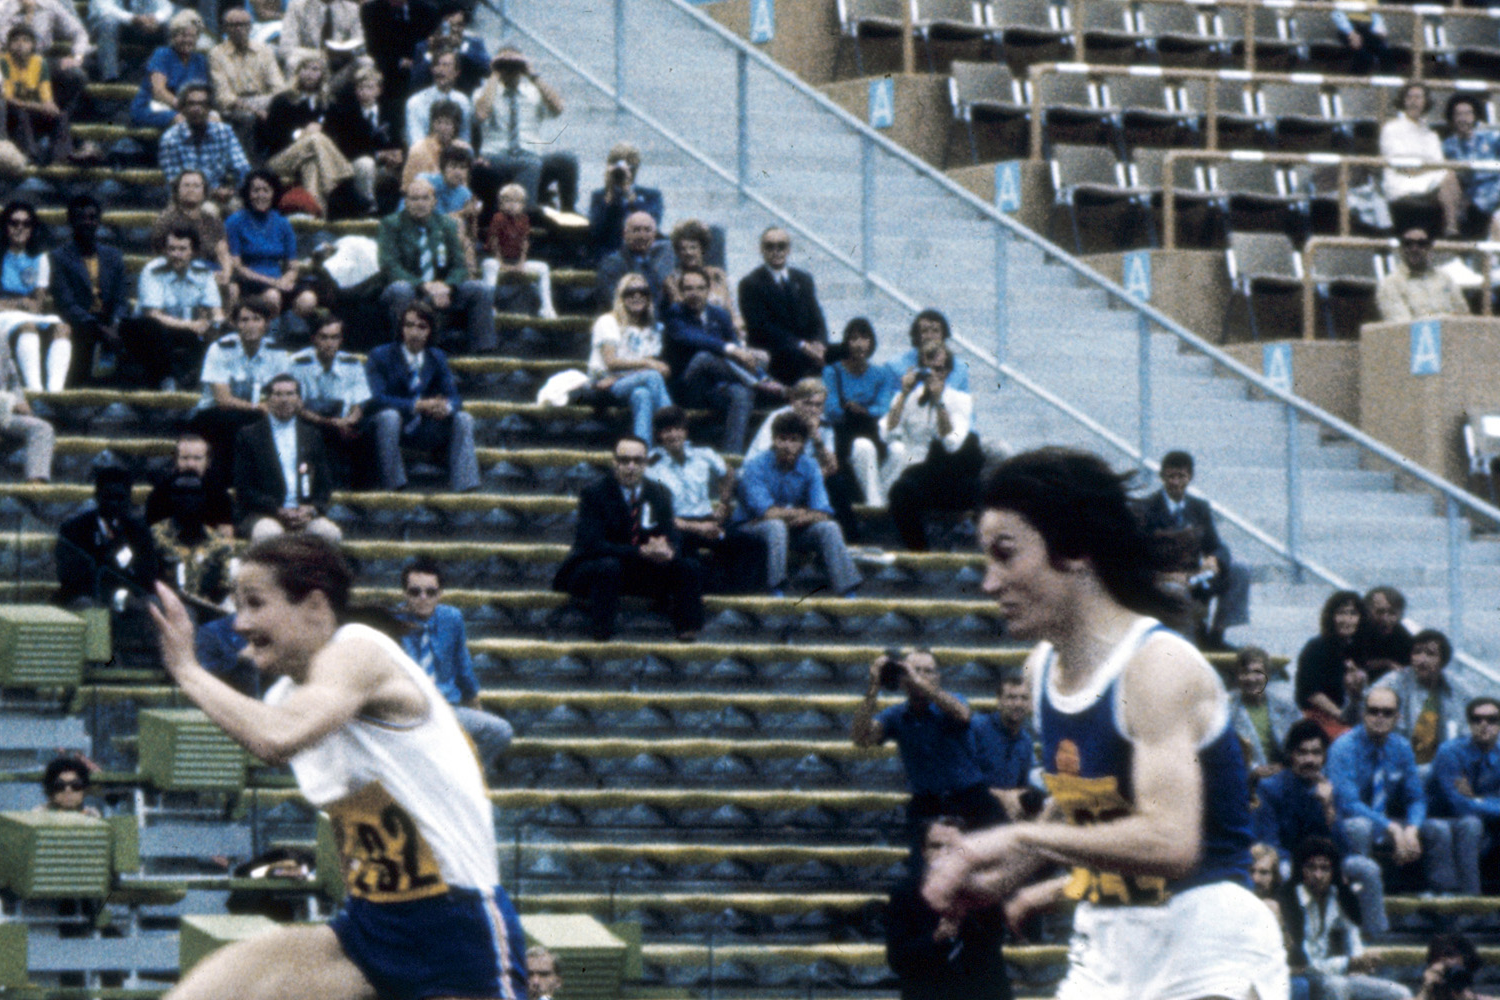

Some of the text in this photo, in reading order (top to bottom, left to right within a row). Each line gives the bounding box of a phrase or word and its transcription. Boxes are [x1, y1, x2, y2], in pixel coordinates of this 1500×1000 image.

[751, 0, 775, 41] A
[870, 80, 894, 127] A
[997, 165, 1021, 211] A
[1126, 254, 1150, 301] A
[1265, 347, 1292, 393] A
[1411, 323, 1441, 374] A
